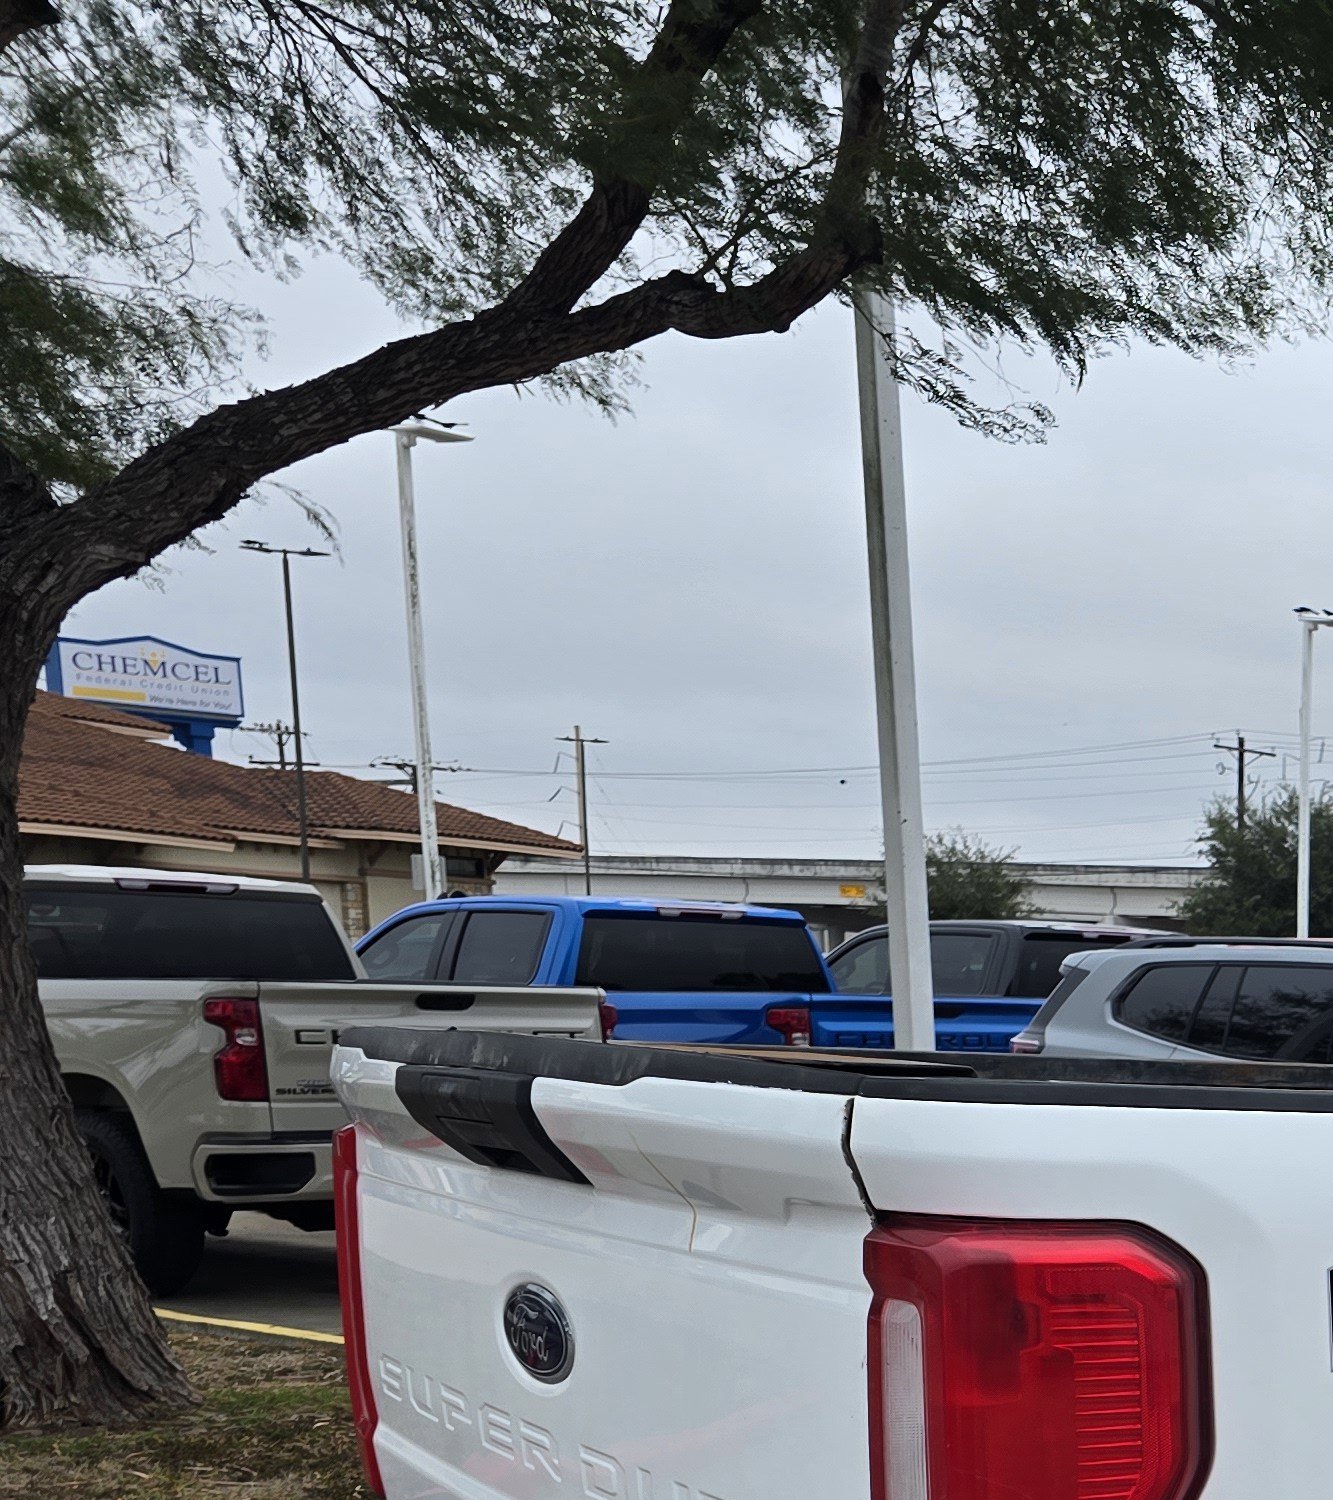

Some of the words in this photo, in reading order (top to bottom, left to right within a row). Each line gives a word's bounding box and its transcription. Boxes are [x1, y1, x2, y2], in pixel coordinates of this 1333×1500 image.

[72, 651, 231, 685] CHEMCEL
[75, 672, 132, 687] Federal
[139, 677, 184, 692] Credit
[190, 685, 230, 697] Union
[275, 1087, 335, 1096] SILVER
[511, 1303, 549, 1362] Ford
[379, 1353, 562, 1483] SUPER
